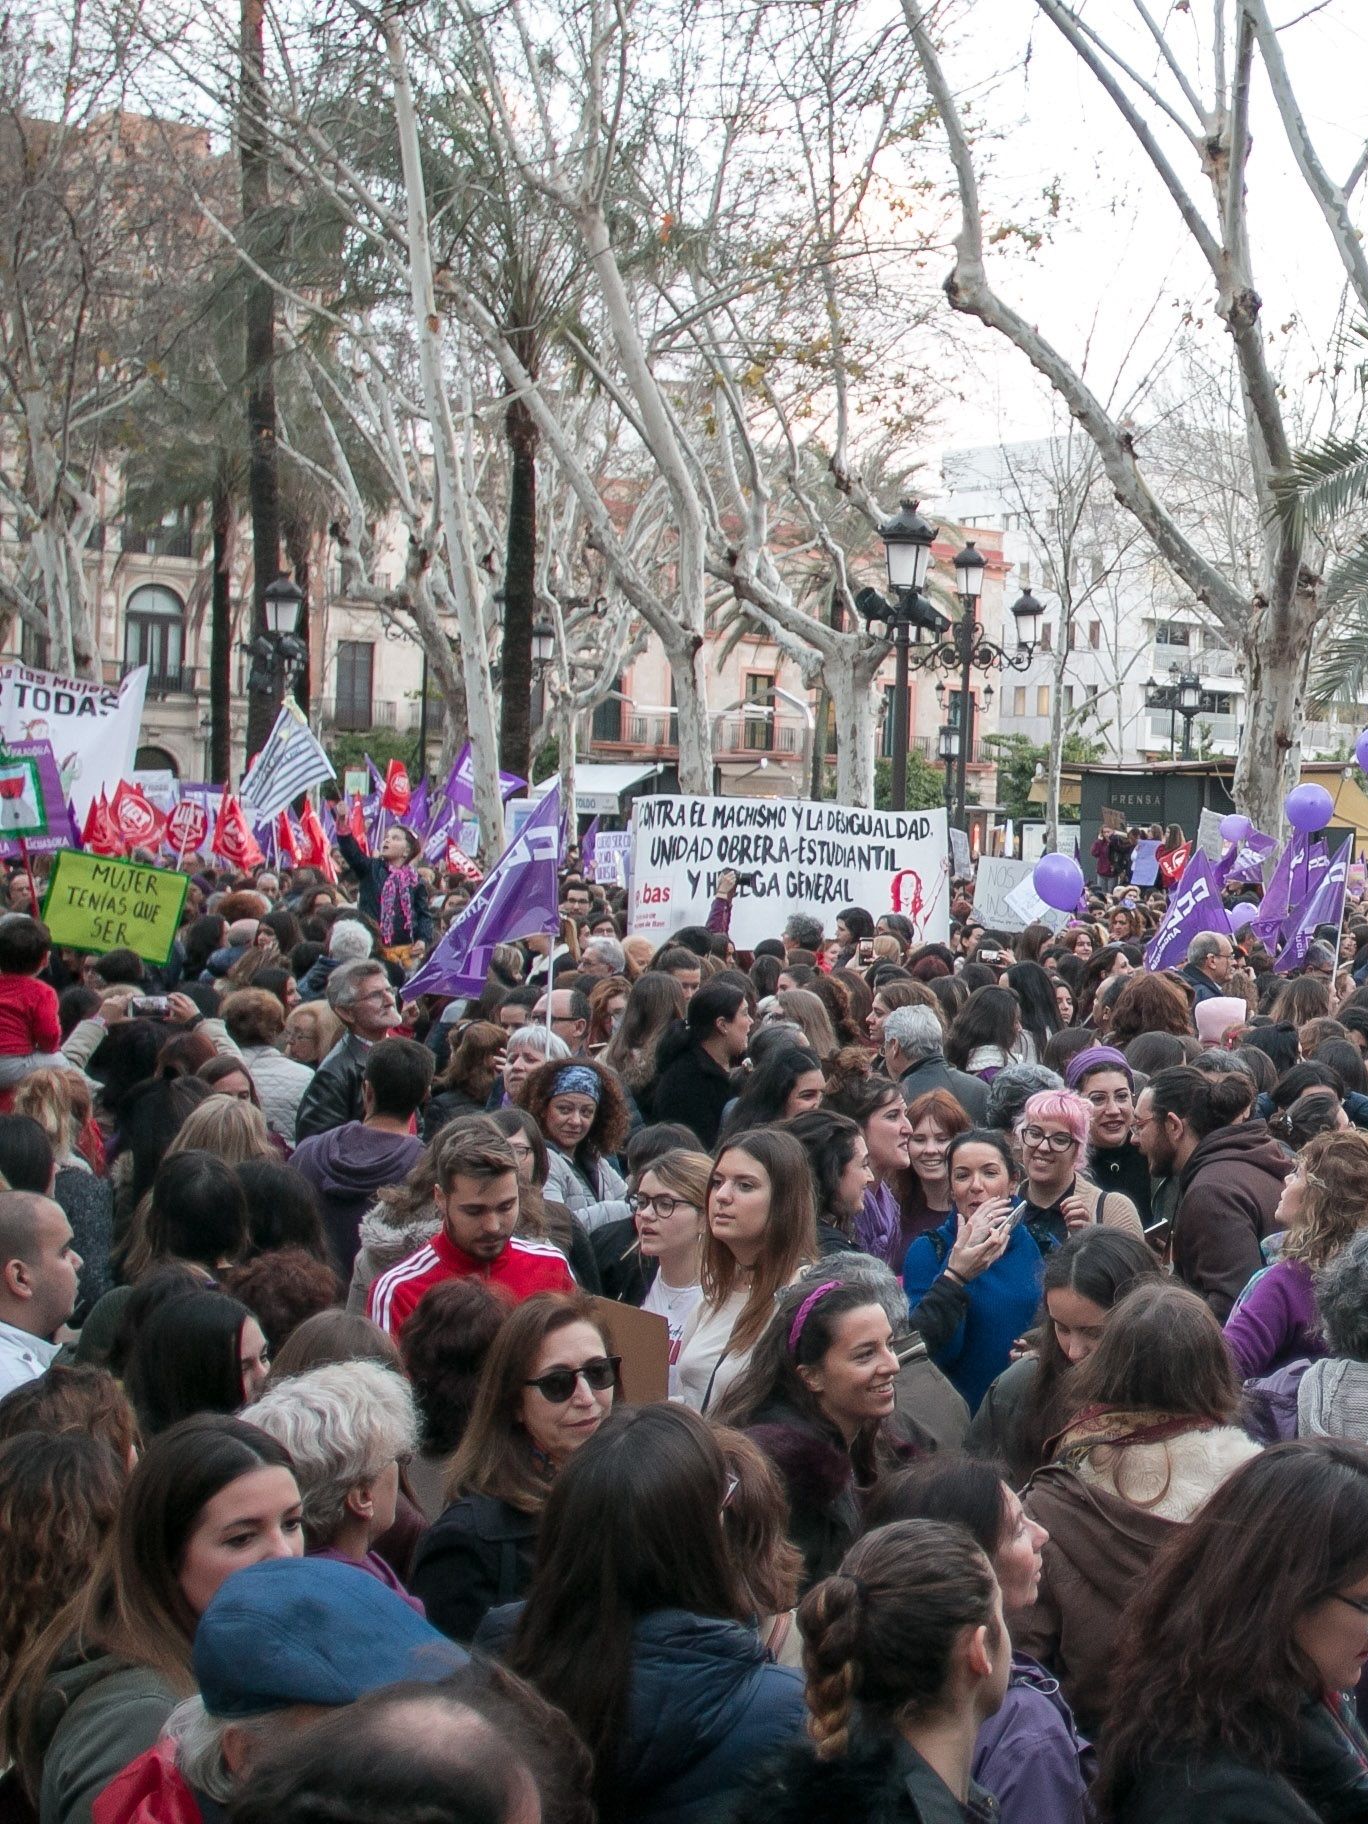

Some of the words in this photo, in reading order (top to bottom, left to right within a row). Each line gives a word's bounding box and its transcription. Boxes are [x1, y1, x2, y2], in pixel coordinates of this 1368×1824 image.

[639, 799, 686, 829] CONTRA
[690, 800, 707, 828] EL
[712, 804, 787, 831] MACHISMO
[791, 806, 803, 832] Y
[806, 808, 823, 832] LA
[1111, 794, 1161, 806] PRENSA
[650, 834, 713, 870] UNIDAD
[717, 834, 902, 873] OBRERA-ESTUDIANTIL
[92, 864, 158, 895] MUJER
[687, 868, 701, 900] Y
[786, 870, 854, 904] GENERAL
[133, 901, 161, 924] QUE
[90, 917, 130, 946] SER
